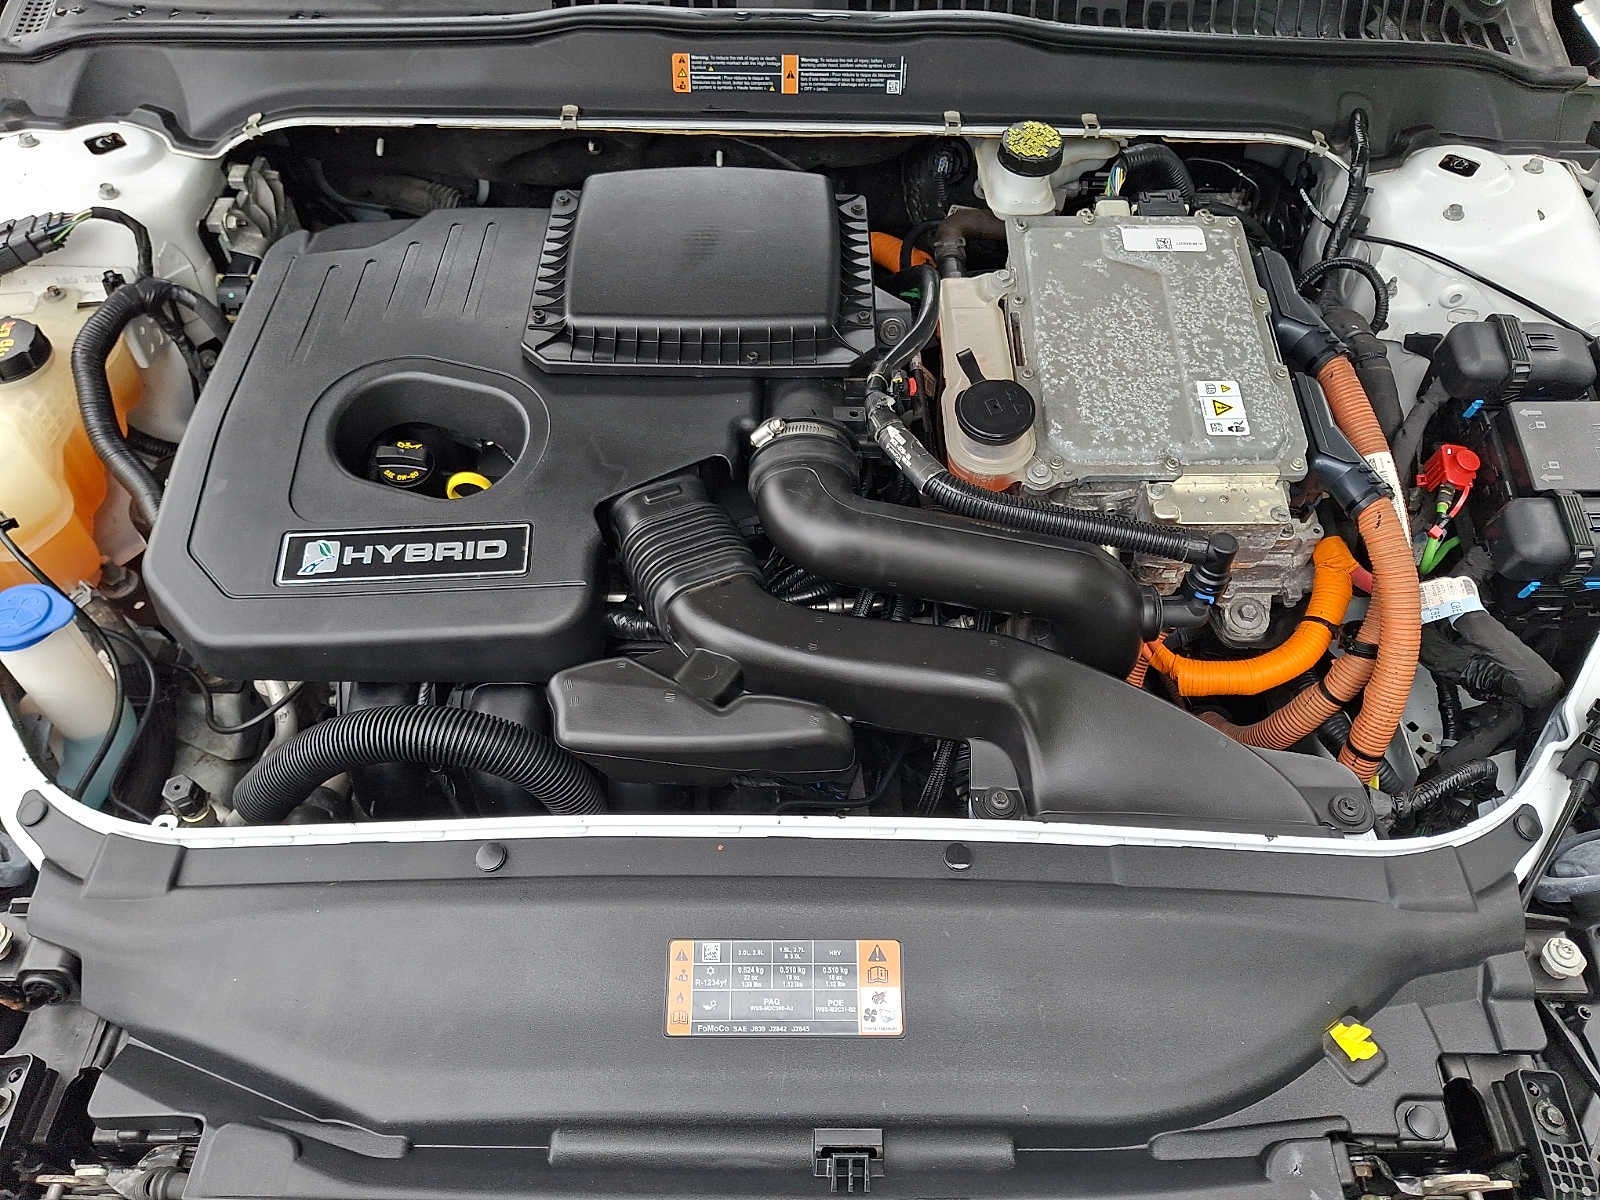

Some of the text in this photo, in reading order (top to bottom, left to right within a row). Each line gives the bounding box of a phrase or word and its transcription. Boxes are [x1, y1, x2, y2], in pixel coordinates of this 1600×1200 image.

[342, 540, 508, 566] HYBRID
[798, 966, 806, 976] kg
[840, 966, 849, 976] kg
[695, 978, 728, 988] R-1234yf
[697, 1024, 730, 1032] FoMoCo
